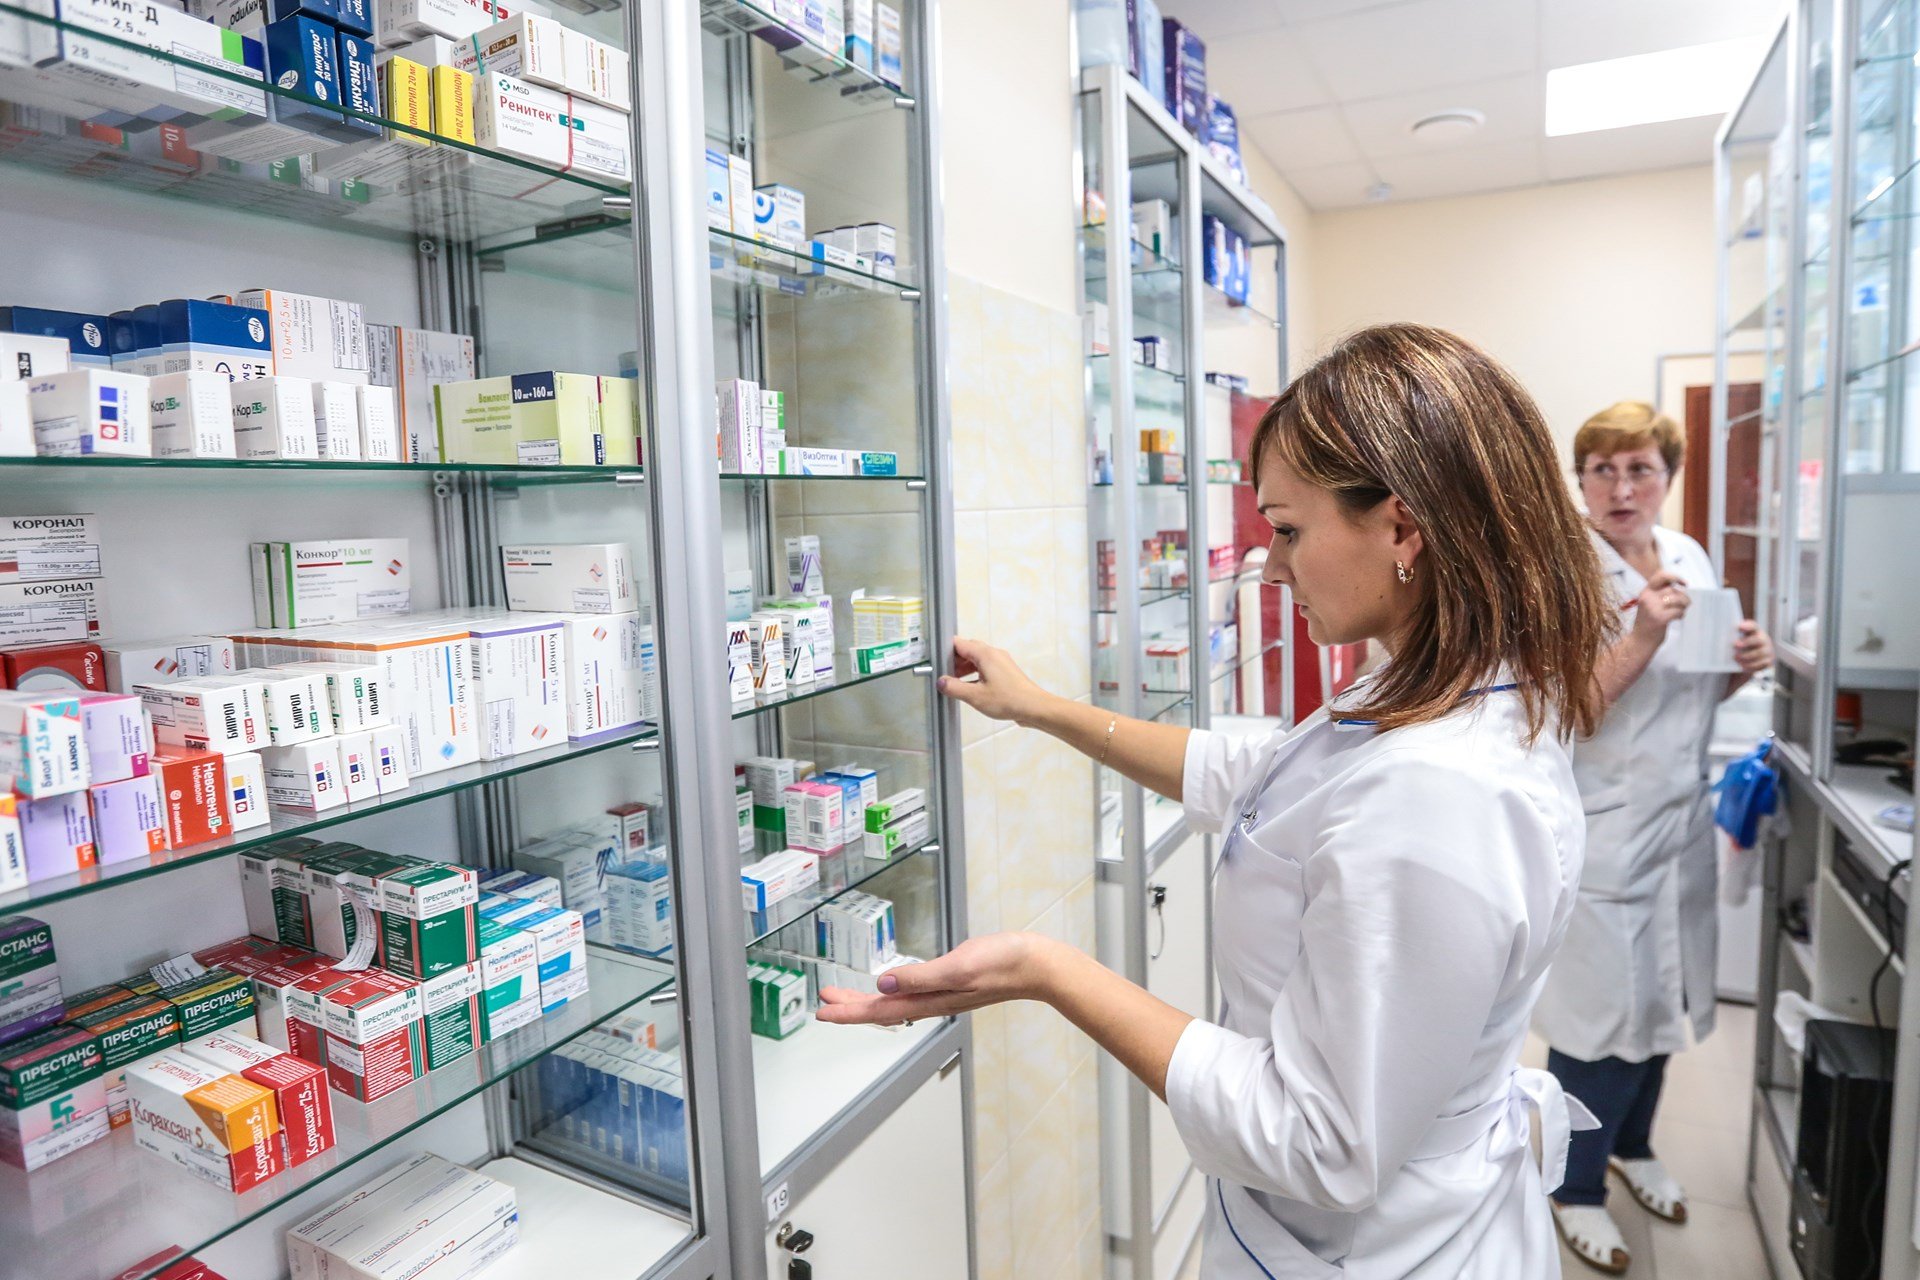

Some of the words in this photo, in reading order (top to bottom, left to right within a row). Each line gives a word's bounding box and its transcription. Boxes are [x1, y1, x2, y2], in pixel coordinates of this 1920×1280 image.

[113, 17, 133, 34] 2,5
[71, 44, 90, 60] 28
[314, 33, 324, 80] Аккупро
[408, 75, 417, 87] 20
[513, 85, 530, 96] MSD
[454, 72, 464, 118] МОНОПРИЛ
[500, 96, 553, 123] Ренитек
[164, 126, 179, 142] 10
[455, 118, 464, 129] 20
[282, 349, 293, 360] 10
[514, 389, 522, 400] 10
[236, 404, 252, 418] Кор
[802, 451, 838, 461] ВизОптик
[865, 453, 894, 465] СЛЕЗИН
[13, 518, 84, 530] КОРОНАЛ
[295, 549, 338, 562] Конкор
[343, 547, 355, 557] 10
[360, 548, 372, 556] мг
[24, 582, 94, 596] КОРОНАЛ
[454, 644, 463, 680] Конкор
[548, 633, 558, 673] Конкор
[83, 658, 94, 685] actavis
[368, 682, 379, 716] БИПРОЛ
[457, 685, 466, 703] Кор
[223, 702, 239, 740] БИПРОЛ
[291, 694, 304, 730] БИПРОЛ
[585, 691, 594, 730] Конкор
[36, 736, 51, 753] 2,5
[68, 734, 80, 771] SANDOZ
[192, 765, 203, 806] Небиволол
[203, 762, 220, 816] Невотенз
[173, 802, 181, 811] 30
[174, 811, 183, 843] таблеток
[6, 832, 19, 869] SANDOZ
[423, 884, 467, 905] ПРЕСТАРИУМ
[427, 977, 469, 1000] ПРЕСТАРИУМ
[185, 987, 249, 1019] ПРЕСТАНС
[362, 1001, 409, 1025] ПРЕСТАРИУМ
[400, 1013, 409, 1023] 10
[102, 1014, 173, 1048] ПРЕСТАНС
[19, 1044, 97, 1085] ПРЕСТАНС
[132, 1098, 193, 1142] Кораксан
[194, 1126, 204, 1148] 5
[247, 1115, 262, 1126] 5
[306, 1108, 318, 1159] Кораксан
[255, 1127, 270, 1182] Кораксан
[773, 1189, 787, 1211] 19
[296, 1202, 347, 1234] Кордарон
[359, 1229, 410, 1264] Кордарон
